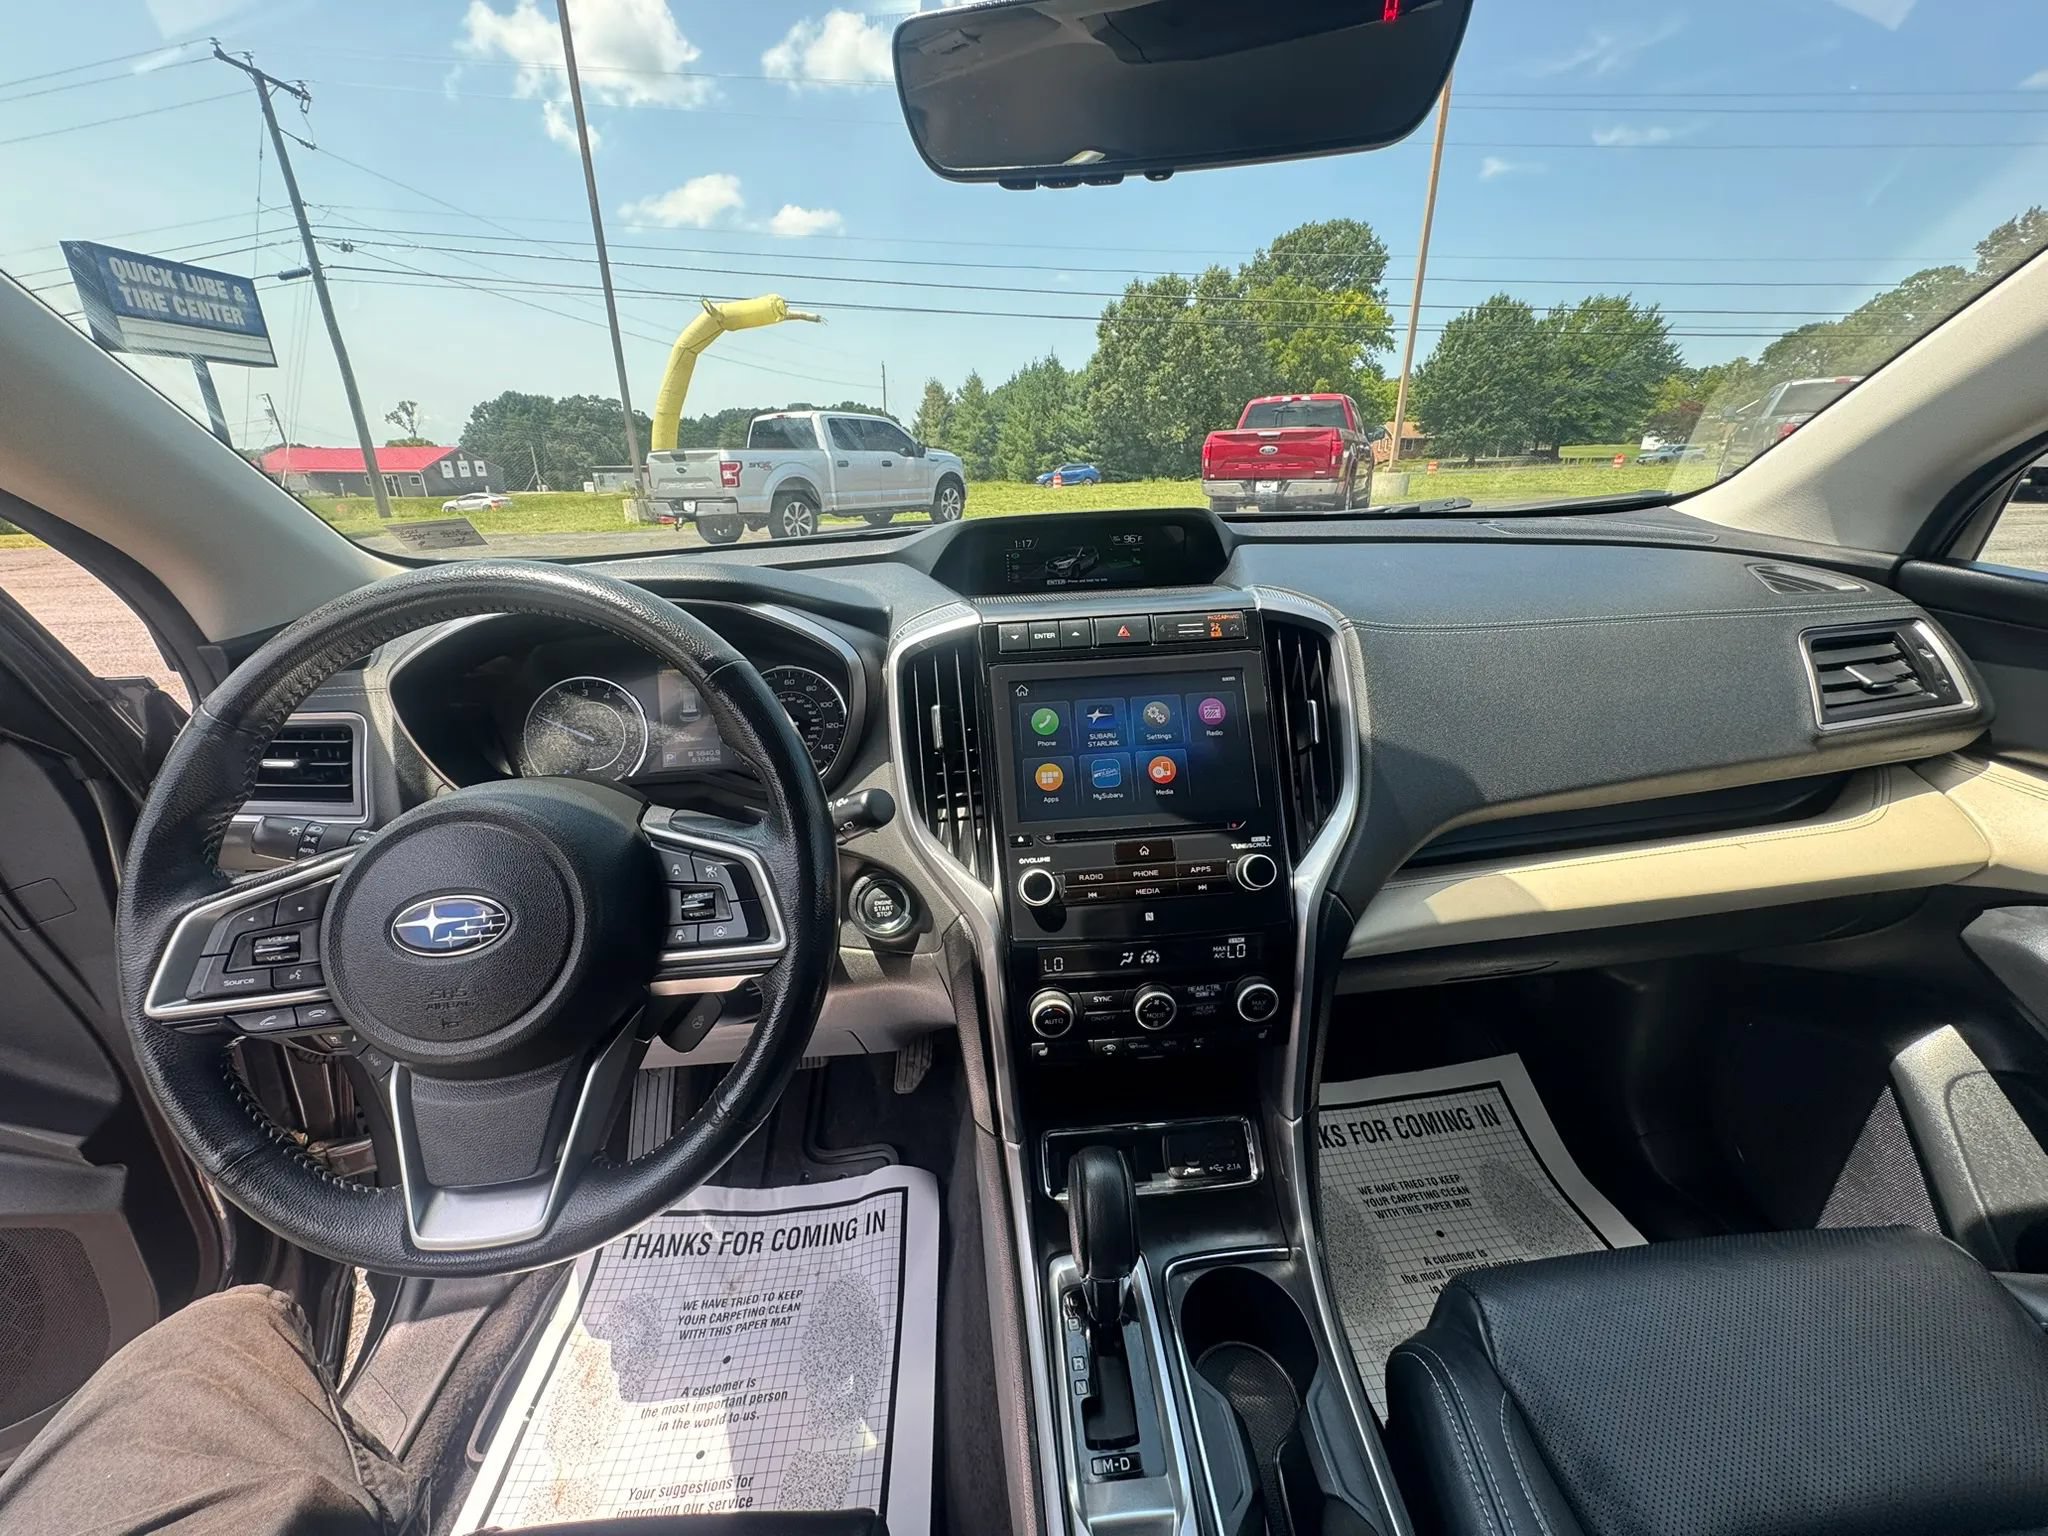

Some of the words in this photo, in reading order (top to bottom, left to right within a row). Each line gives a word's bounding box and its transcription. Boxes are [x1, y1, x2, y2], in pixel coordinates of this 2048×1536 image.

[108, 256, 177, 289] QUICK
[180, 272, 229, 299] LUBE
[232, 285, 247, 303] &
[118, 285, 170, 313] TIRE
[171, 295, 246, 326] CENTER
[1014, 539, 1033, 548] 1:17
[1033, 631, 1056, 640] ENTER
[582, 689, 588, 697] 3
[1088, 732, 1117, 740] SUBARU
[1146, 733, 1172, 742] Settings
[1206, 729, 1224, 737] Radio
[1087, 740, 1120, 748] STARLINK
[1092, 791, 1124, 801] MySubaru
[1155, 788, 1174, 796] Media
[1043, 796, 1059, 804] Apps
[1132, 869, 1159, 878] PHONE
[1190, 865, 1212, 874] APPS
[1078, 873, 1104, 881] RADIO
[1135, 887, 1160, 896] MEDIA
[1044, 957, 1064, 972] LO
[224, 977, 254, 986] Source
[1093, 995, 1113, 1003] SYNC
[1146, 1011, 1166, 1019] MODE
[1044, 1017, 1064, 1026] AUTO
[1347, 1119, 1392, 1145] FOR
[1392, 1107, 1475, 1140] COMING
[1474, 1103, 1502, 1128] IN
[1358, 1185, 1375, 1196] WE
[1374, 1182, 1398, 1194] HAVE
[1398, 1178, 1425, 1191] TRIED
[1424, 1176, 1439, 1187] TO
[1438, 1174, 1460, 1185] KEEP
[1362, 1196, 1391, 1209] YOUR
[1390, 1189, 1441, 1204] CARPETING
[1440, 1185, 1471, 1198] CLEAN
[1374, 1208, 1401, 1220] WITH
[1400, 1204, 1423, 1216] THIS
[1422, 1200, 1453, 1213] PAPER
[1452, 1198, 1472, 1209] MAT
[622, 1232, 712, 1260] THANKS
[718, 1230, 764, 1257] FOR
[771, 1218, 858, 1252] COMING
[865, 1208, 886, 1236] IN
[1423, 1256, 1433, 1266] A
[1432, 1251, 1476, 1264] customer
[1476, 1248, 1488, 1258] is
[1400, 1274, 1418, 1284] the
[1420, 1270, 1444, 1282] most
[1428, 1284, 1440, 1294] in
[683, 1300, 698, 1311] WE
[701, 1298, 728, 1310] HAVE
[730, 1294, 760, 1308] TRIED
[762, 1292, 775, 1302] TO
[778, 1289, 804, 1301] KEEP
[678, 1314, 707, 1326] YOUR
[709, 1306, 766, 1324] CARPETING
[768, 1302, 802, 1315] CLEAN
[679, 1328, 706, 1341] WITH
[709, 1324, 733, 1338] THIS
[735, 1318, 768, 1333] PAPER
[770, 1316, 792, 1328] MAT
[680, 1386, 690, 1398] A
[692, 1380, 744, 1397] customer
[746, 1377, 756, 1388] is
[640, 1408, 659, 1420] the
[661, 1403, 690, 1416] most
[692, 1394, 748, 1414] important
[748, 1390, 788, 1406] person
[658, 1421, 670, 1432] in
[672, 1418, 690, 1430] the
[694, 1414, 726, 1428] world
[728, 1412, 739, 1424] to
[742, 1410, 760, 1422] us.
[1102, 1457, 1130, 1474] M-D
[628, 1487, 656, 1501] Your
[658, 1476, 734, 1500] suggestions
[736, 1474, 754, 1489] for
[682, 1501, 704, 1514] our
[707, 1494, 754, 1514] service
